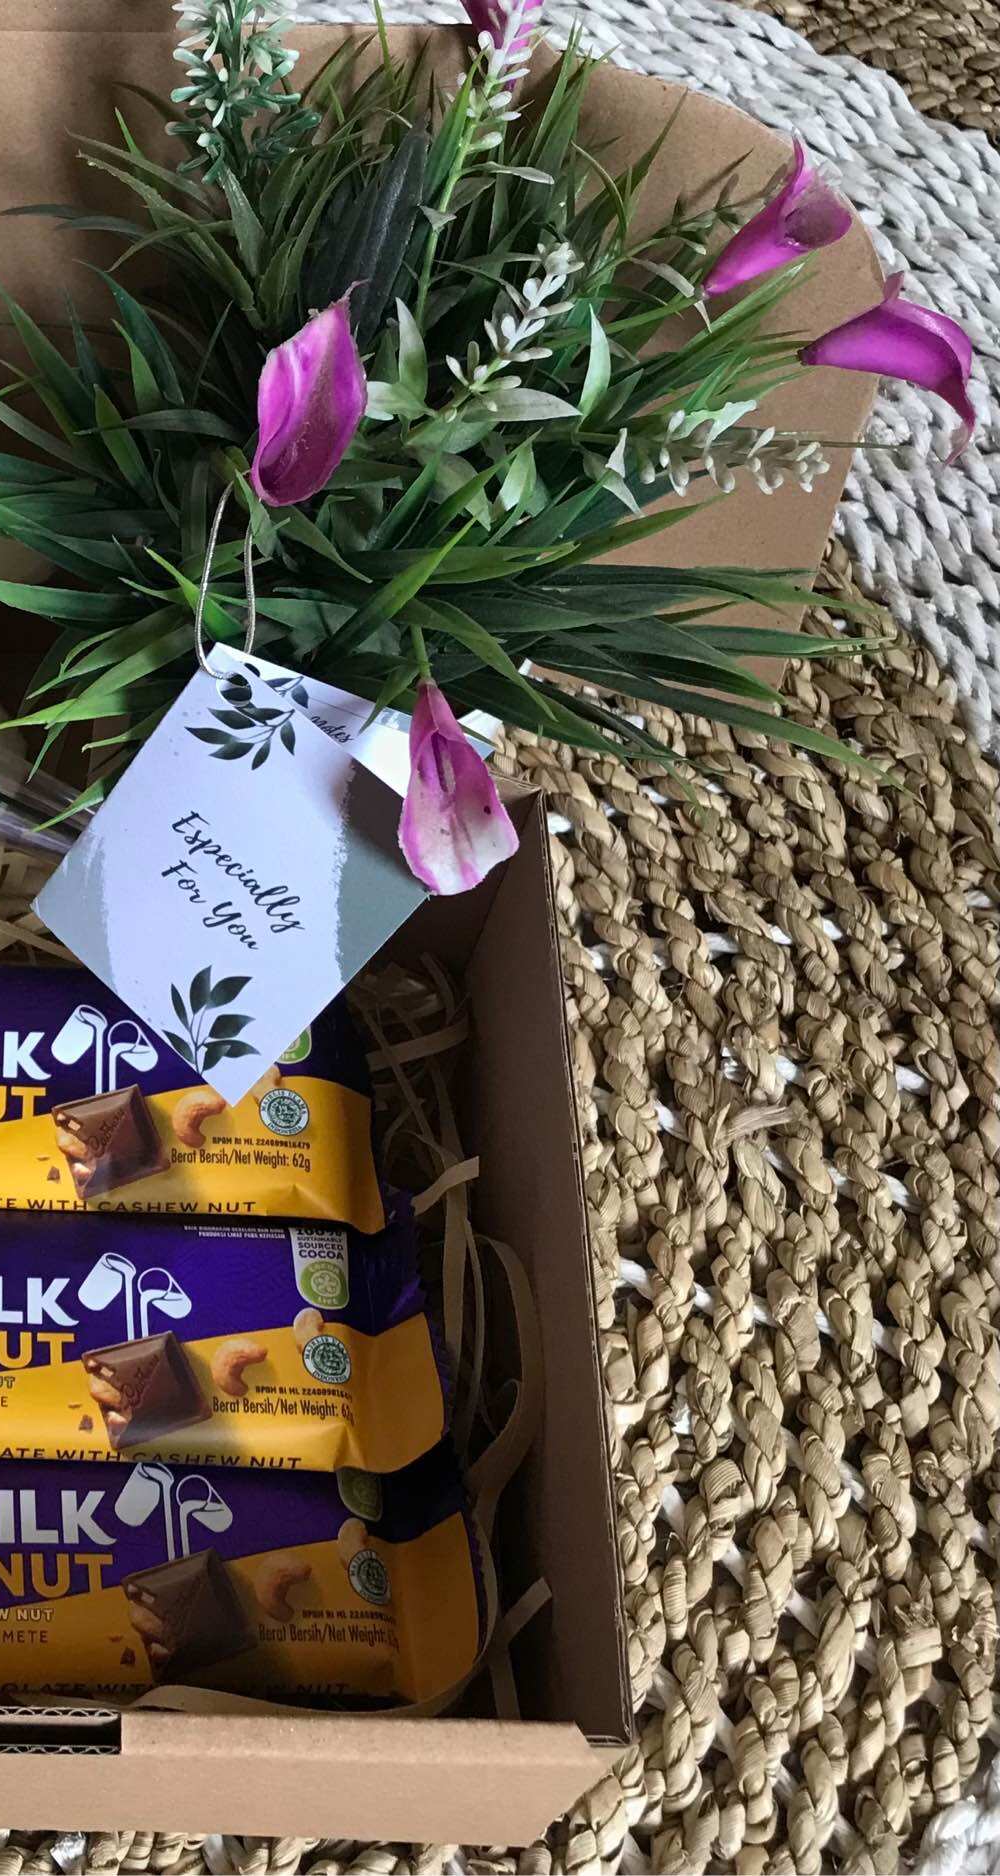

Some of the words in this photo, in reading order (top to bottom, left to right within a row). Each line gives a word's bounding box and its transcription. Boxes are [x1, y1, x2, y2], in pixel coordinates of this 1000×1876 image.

[171, 810, 305, 934] Especially
[161, 859, 208, 907] For
[203, 900, 260, 951] You
[171, 1148, 197, 1163] Berat
[200, 1148, 251, 1166] Bersih/Net
[253, 1149, 290, 1169] Weight:
[292, 1151, 311, 1172] 62g
[26, 1198, 88, 1212] WITH
[98, 1200, 199, 1213] CASHEW
[208, 1201, 257, 1213] NUT
[297, 1242, 344, 1251] SOURCED
[298, 1250, 344, 1260] COCOA
[212, 1396, 239, 1413] Berat
[243, 1397, 298, 1415] Bersih/Net
[300, 1399, 339, 1420] Weight:
[55, 1449, 122, 1463] WITH
[131, 1452, 243, 1467] CASHEW
[249, 1456, 302, 1469] NUT
[16, 1608, 55, 1622] NUT
[2, 1630, 49, 1644] METE
